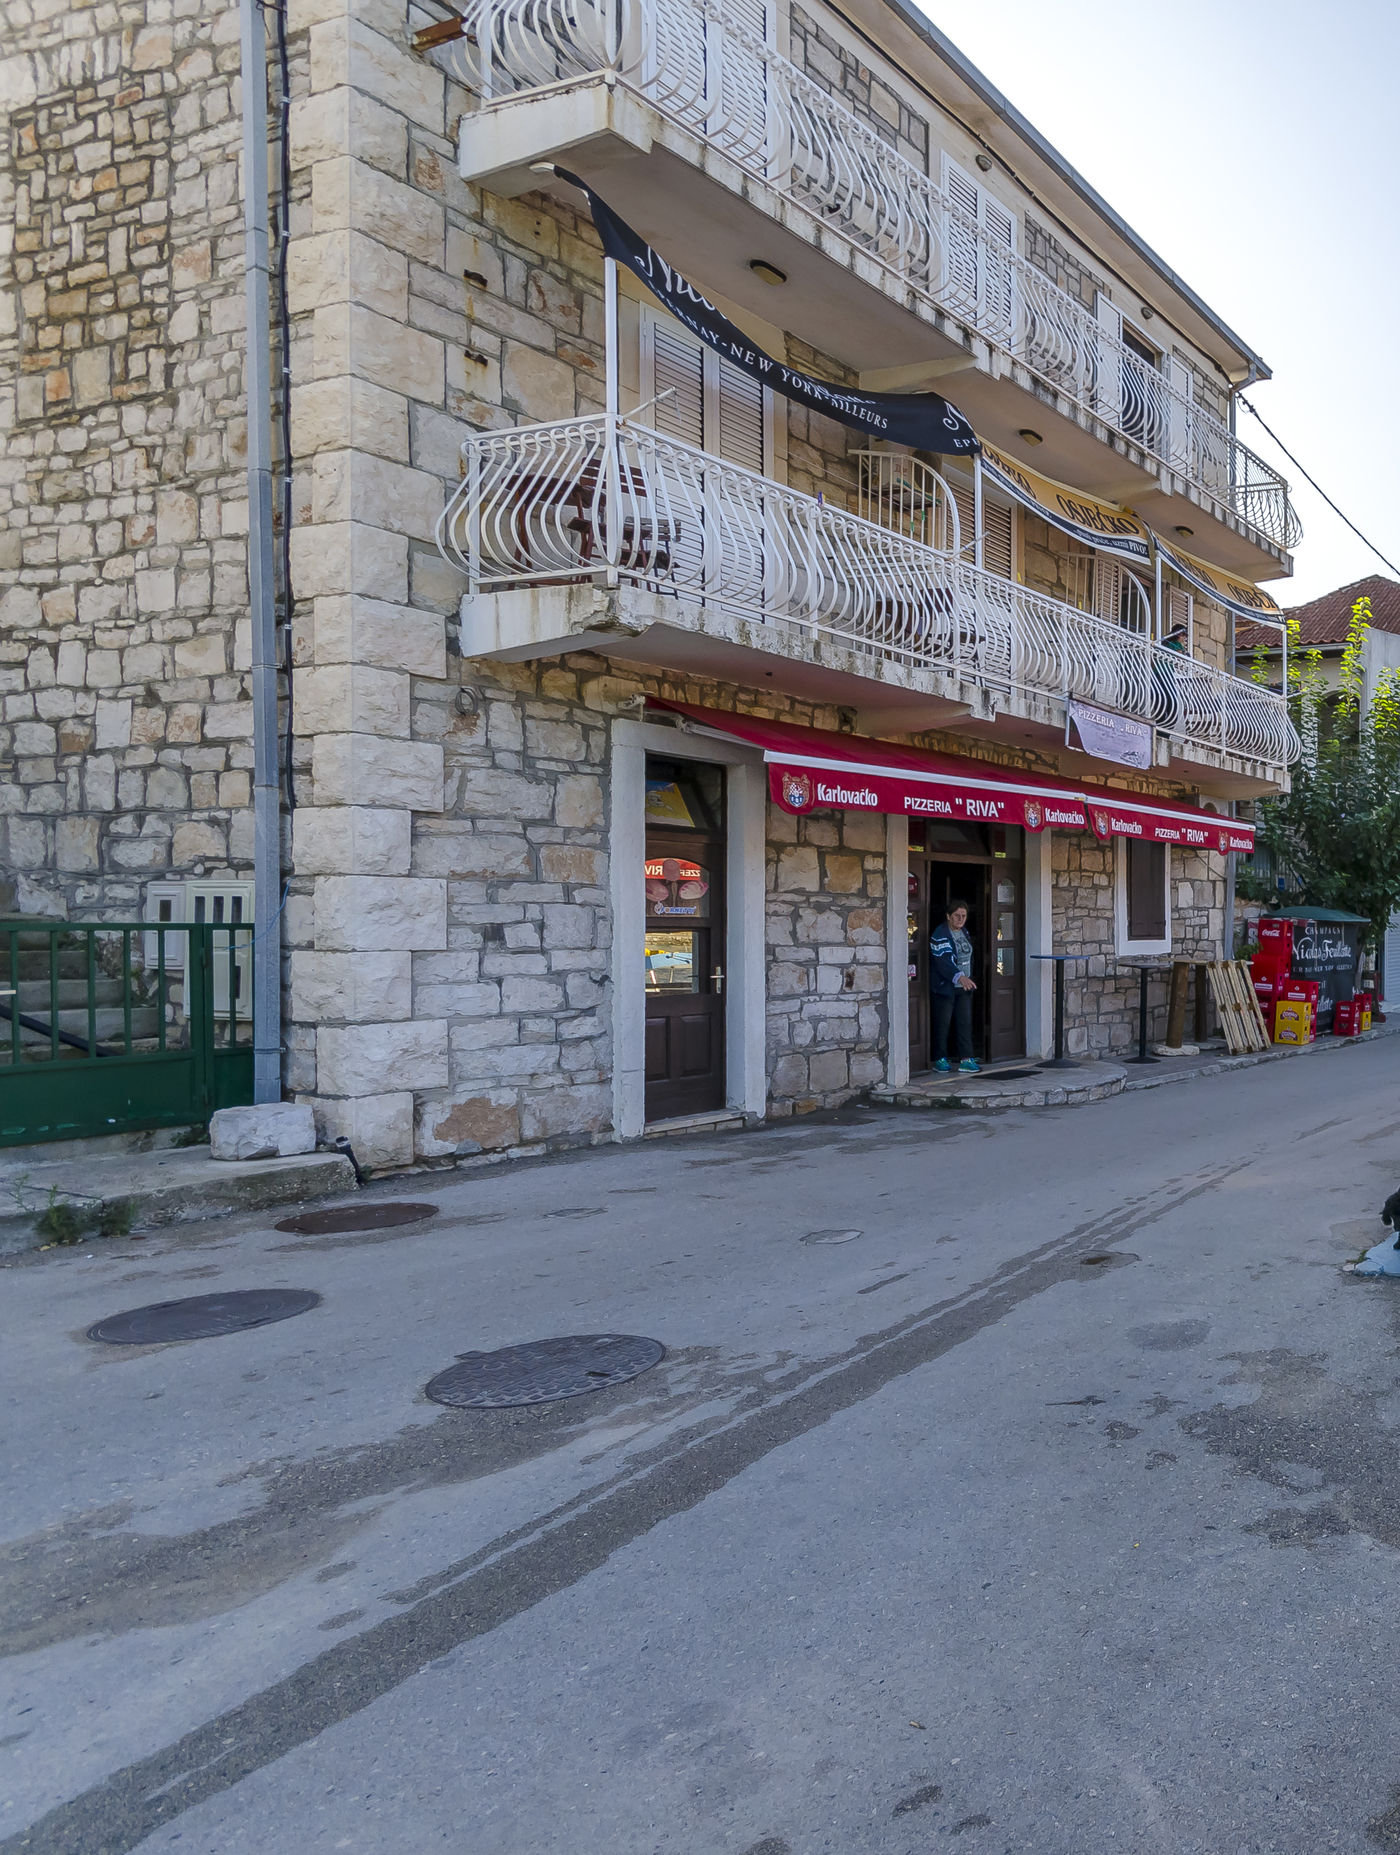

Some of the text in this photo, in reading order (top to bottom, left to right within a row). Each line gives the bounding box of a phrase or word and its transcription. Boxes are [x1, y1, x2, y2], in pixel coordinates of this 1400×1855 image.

[1056, 493, 1140, 535] OSJEČKO
[1078, 708, 1115, 729] PIZZERIA
[817, 782, 878, 807] Karlovačko
[904, 796, 952, 814] PIZZERIA
[1045, 807, 1085, 825] Karlovačko
[1110, 817, 1143, 835] Karlovačko
[1155, 827, 1180, 840] PIZZERIA
